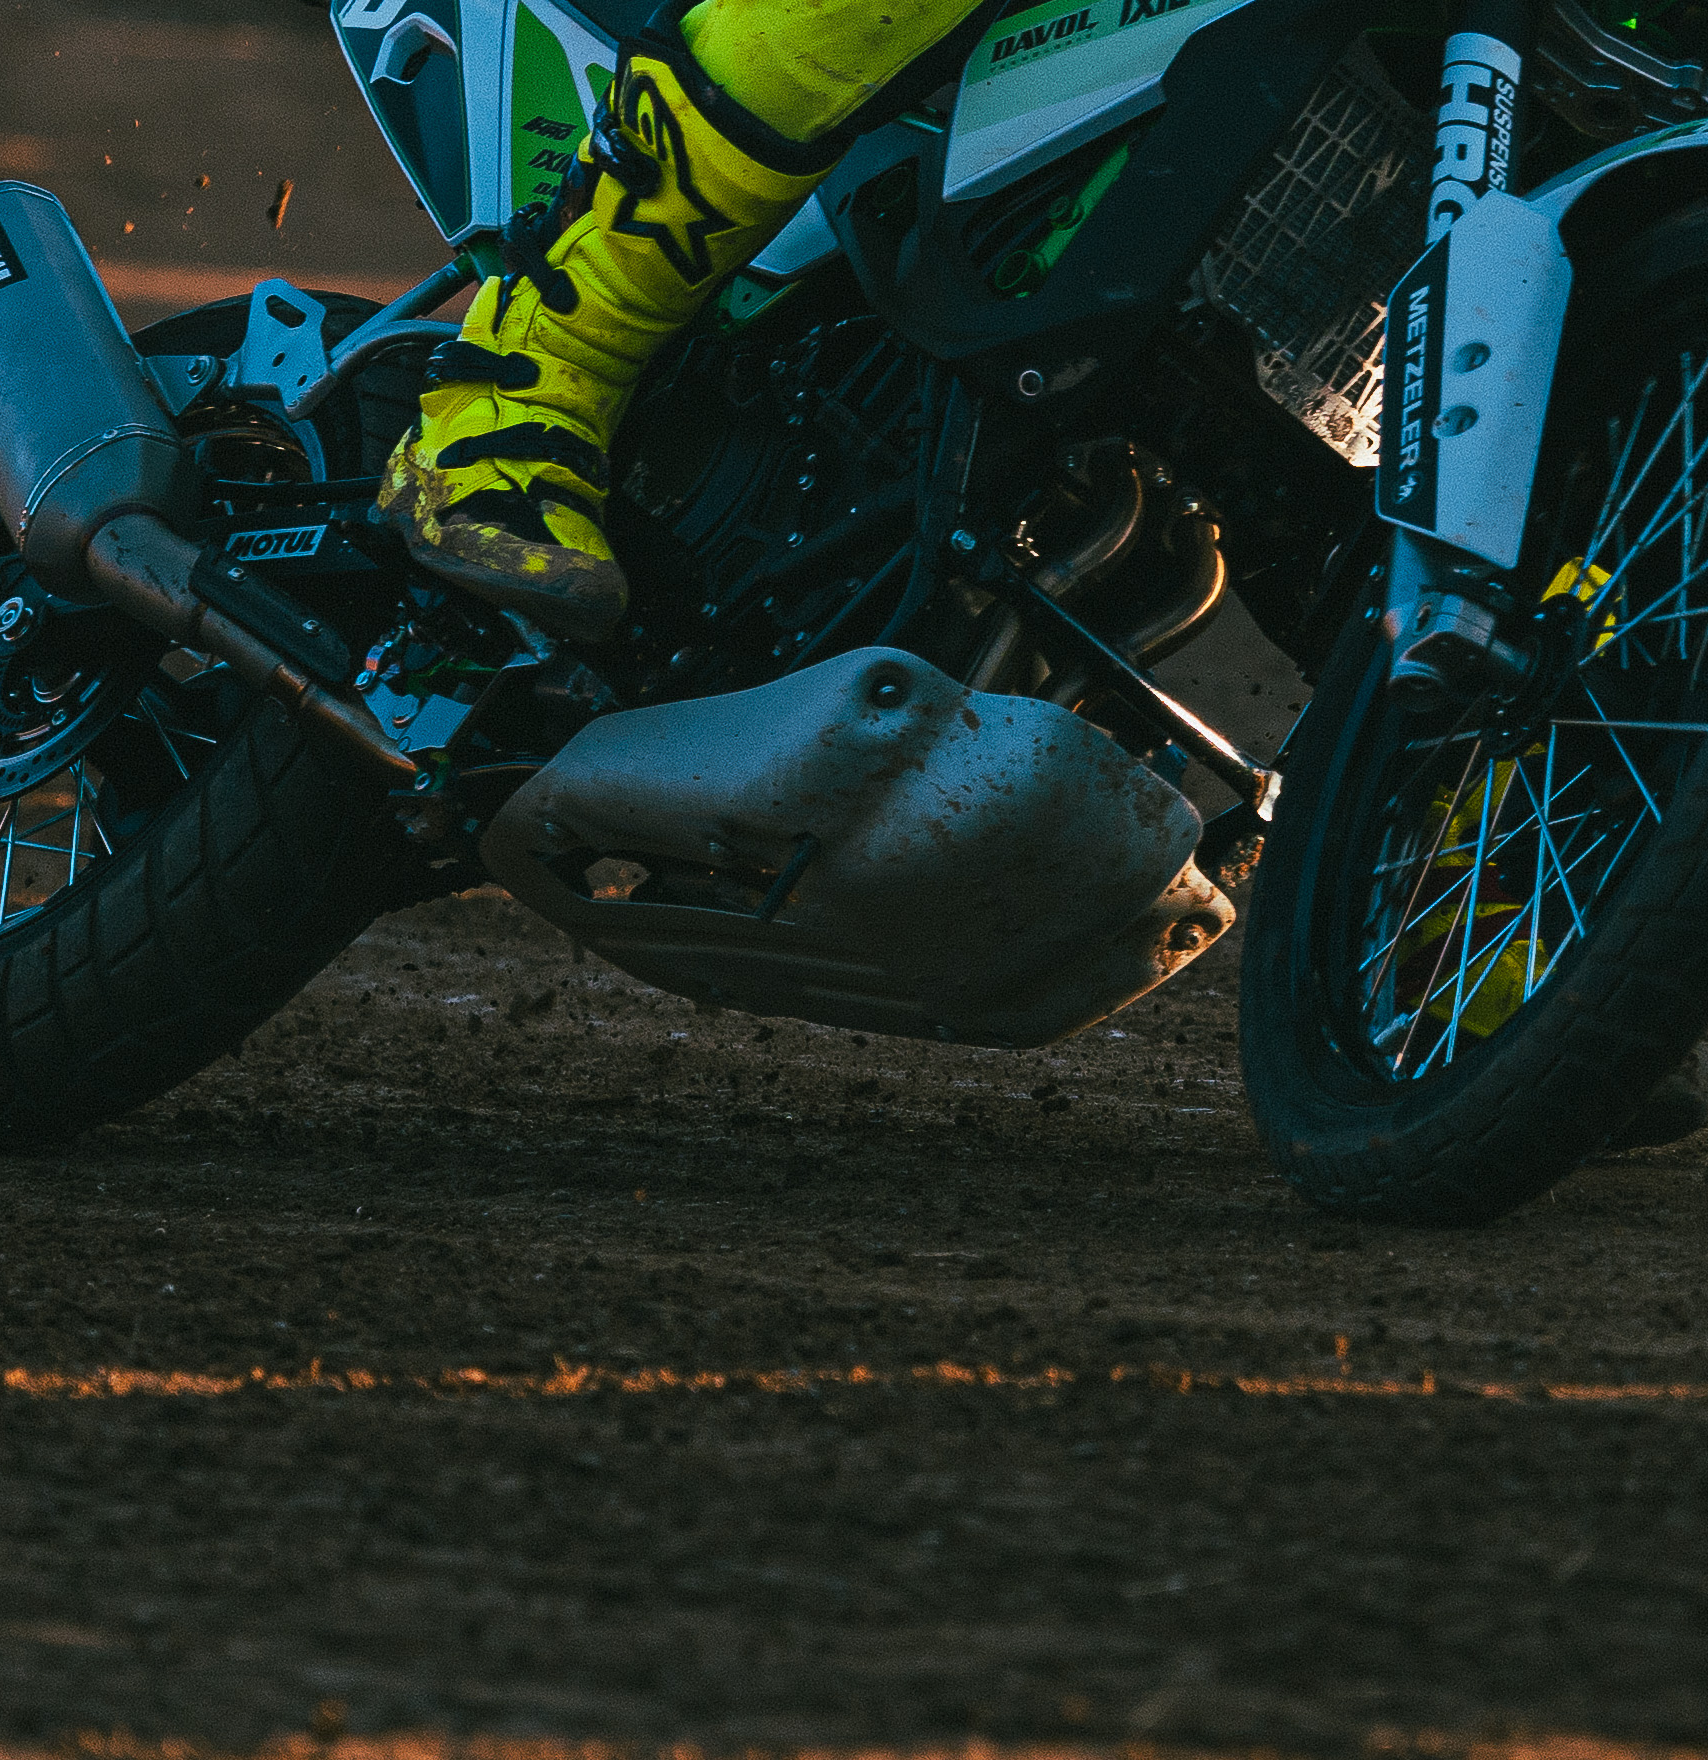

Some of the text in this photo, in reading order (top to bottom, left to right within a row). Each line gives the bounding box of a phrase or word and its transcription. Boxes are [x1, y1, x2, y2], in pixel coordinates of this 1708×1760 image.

[526, 148, 572, 176] IXI
[1488, 78, 1516, 191] SUSPENS
[1399, 285, 1430, 468] METZELER
[228, 531, 319, 559] MOTUL
